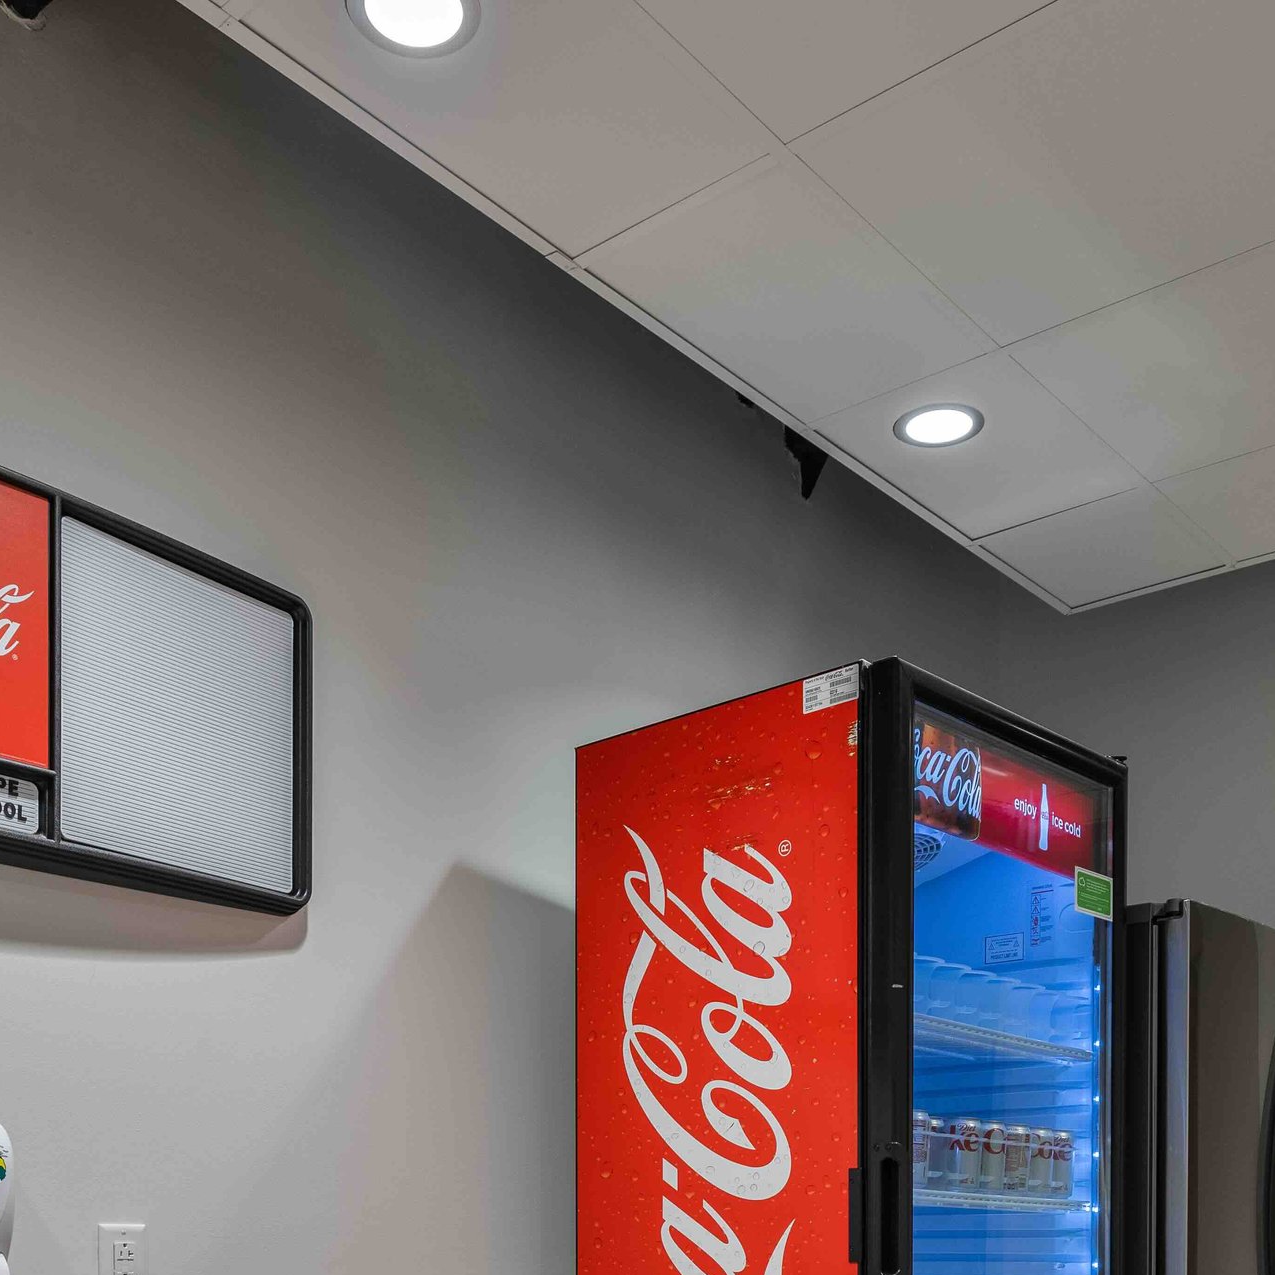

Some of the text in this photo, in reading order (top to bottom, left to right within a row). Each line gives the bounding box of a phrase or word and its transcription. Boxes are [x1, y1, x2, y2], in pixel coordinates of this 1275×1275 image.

[1014, 798, 1037, 820] enjoy
[1052, 812, 1063, 830] ice
[1064, 821, 1082, 838] cold
